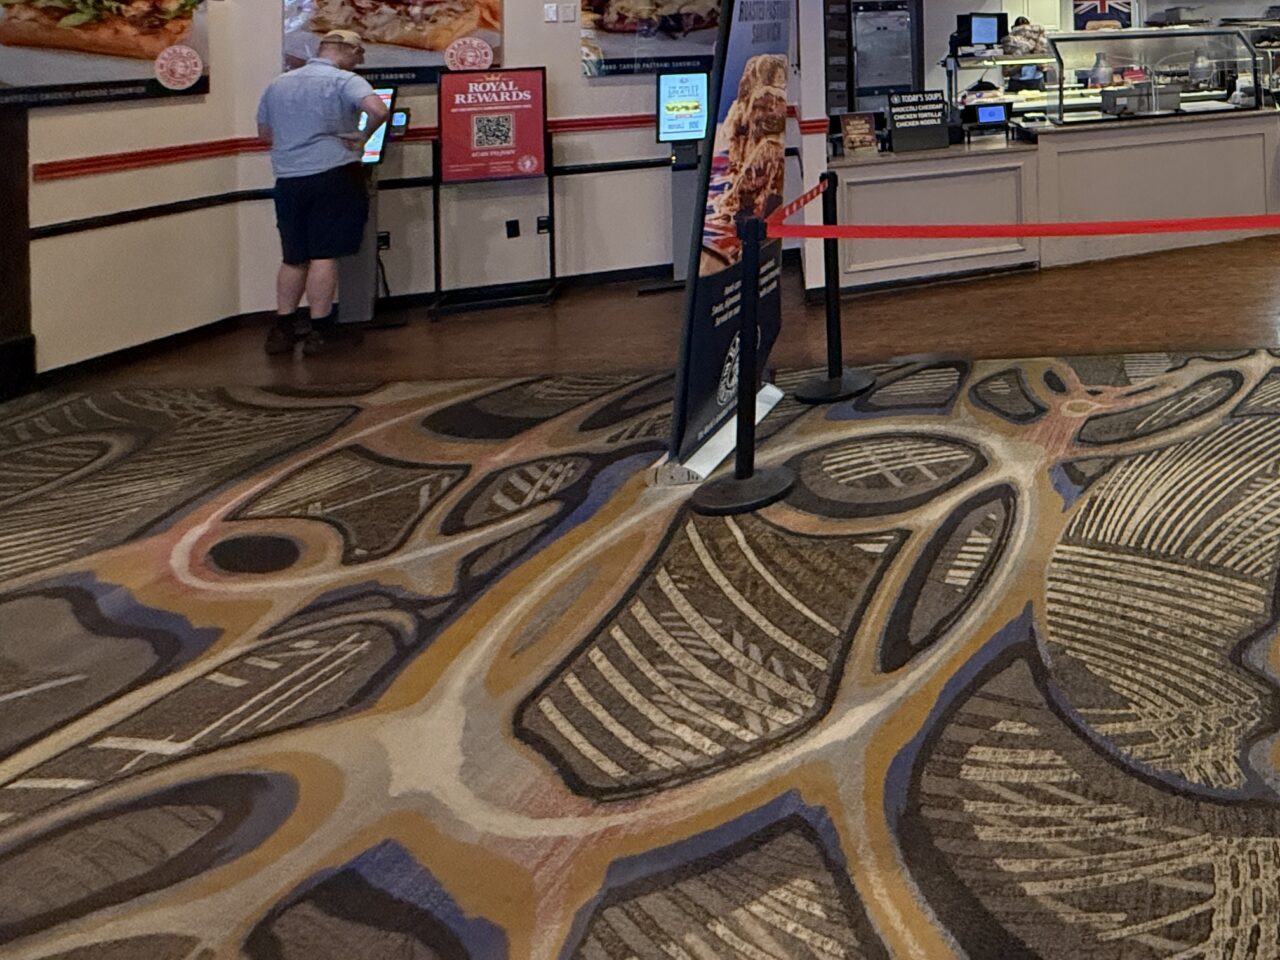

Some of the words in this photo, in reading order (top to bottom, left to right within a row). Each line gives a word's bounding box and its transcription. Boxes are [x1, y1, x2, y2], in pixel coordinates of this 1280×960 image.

[380, 72, 416, 80] SANDWICH
[468, 81, 519, 93] ROYAL
[454, 90, 532, 104] REWARDS
[901, 93, 924, 102] TODAY'S
[925, 93, 943, 101] SOUPS
[891, 105, 917, 113] BROCCOLI
[918, 103, 943, 112] CHEDDAR
[918, 111, 943, 119] TORTILLA
[895, 120, 920, 128] CHICKEN
